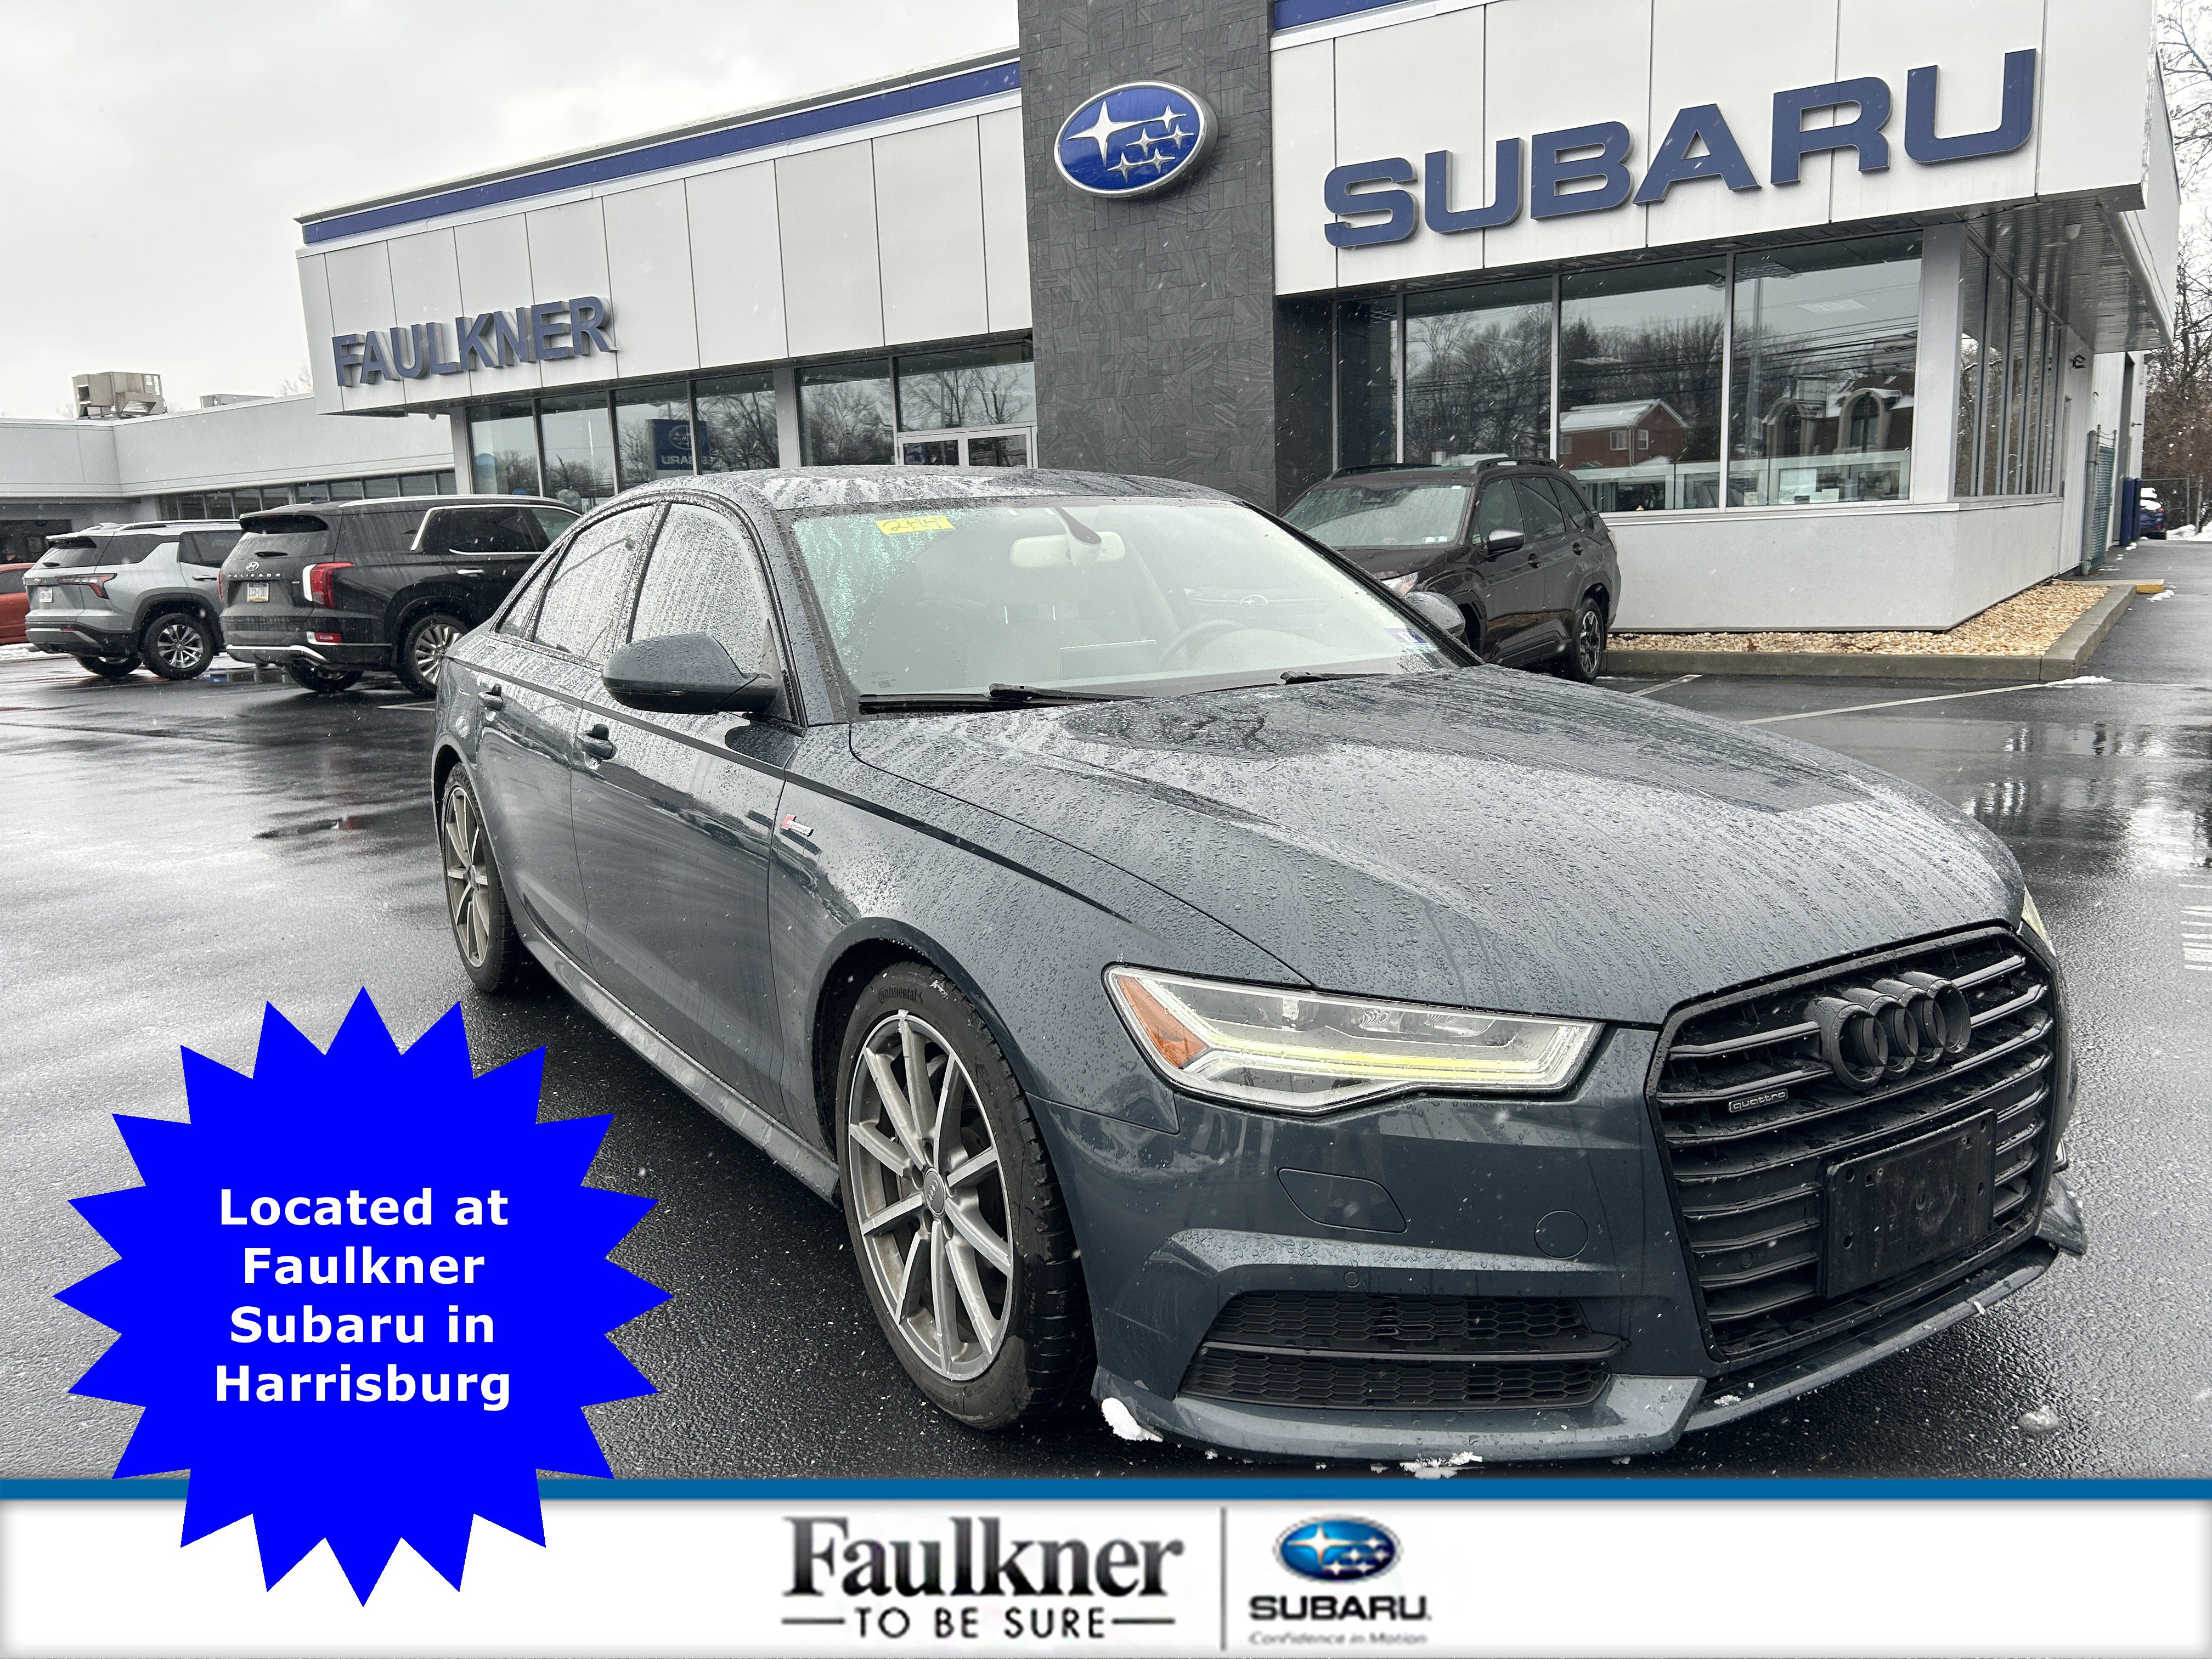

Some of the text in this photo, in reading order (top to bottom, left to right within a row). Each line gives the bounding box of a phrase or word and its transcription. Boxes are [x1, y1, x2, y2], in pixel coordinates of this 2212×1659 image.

[1324, 48, 2038, 248] SUBARU
[331, 296, 618, 387] FAULKNER
[878, 986, 917, 1003] Continental
[1733, 1091, 1786, 1110] quattro
